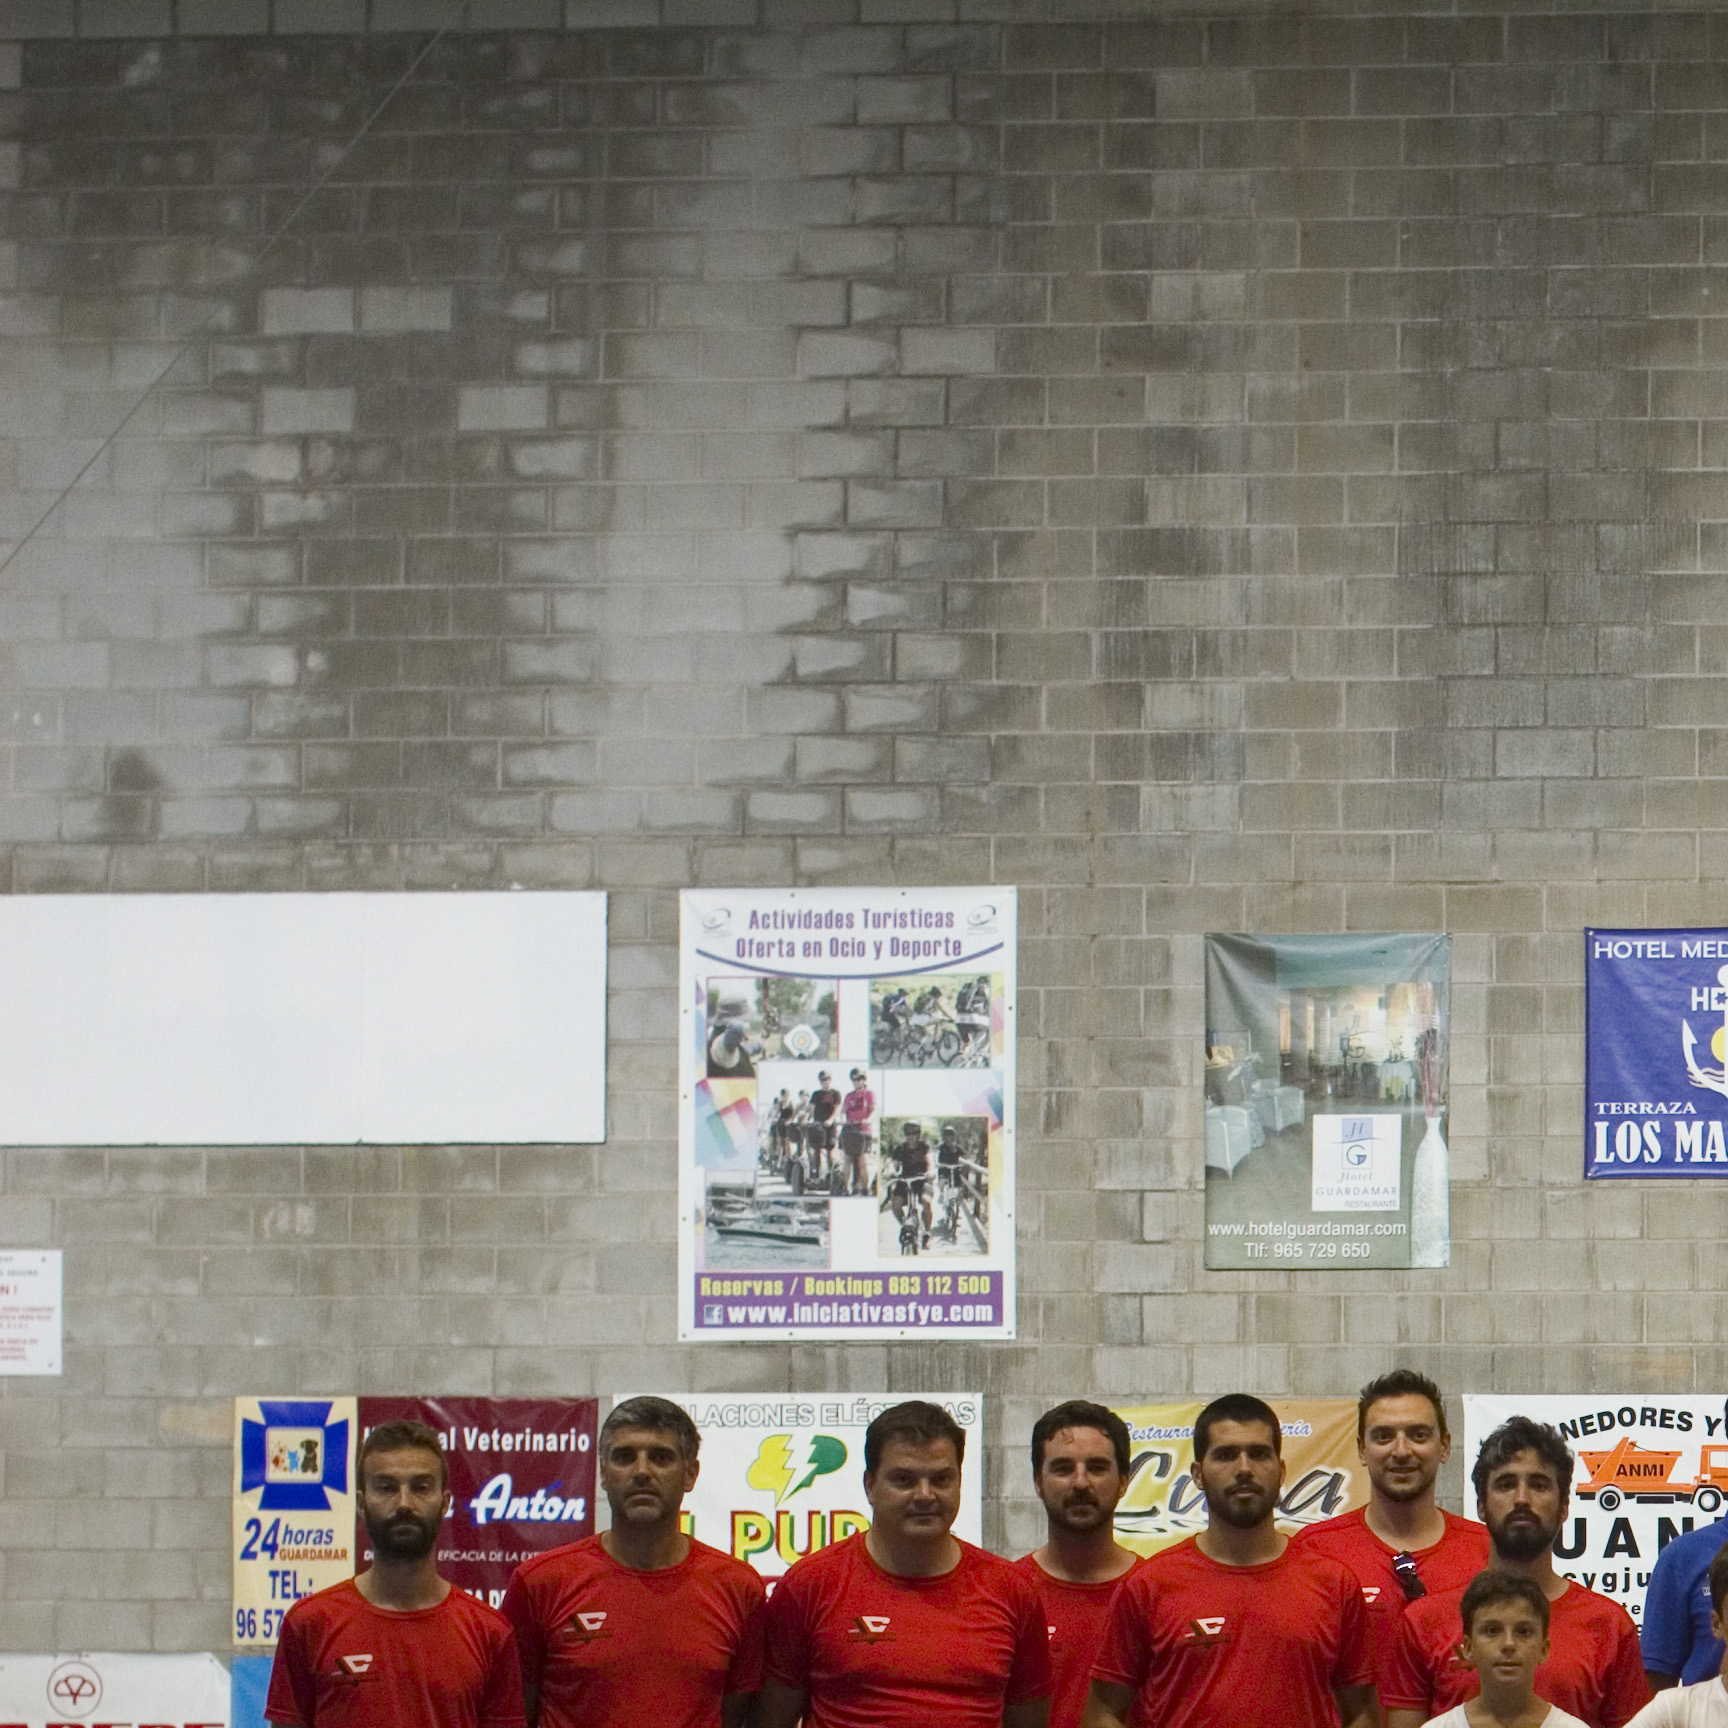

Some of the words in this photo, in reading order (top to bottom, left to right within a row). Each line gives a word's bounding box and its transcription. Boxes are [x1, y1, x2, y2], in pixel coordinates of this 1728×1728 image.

[749, 910, 854, 930] Actividades
[736, 938, 795, 958] Oferta
[802, 941, 822, 957] en
[829, 937, 865, 957] Ocio
[873, 942, 882, 960] y
[890, 938, 961, 959] Deporte
[1594, 941, 1675, 959] HOTEL
[1691, 987, 1709, 1011] H
[1594, 1101, 1697, 1115] TERRAZA
[1594, 1120, 1662, 1163] LOS
[1316, 1186, 1397, 1196] GUARDAMAR
[1208, 1221, 1406, 1239] www.hotelguardamar.com
[1274, 1243, 1303, 1258] 965
[1309, 1243, 1337, 1258] 729
[1342, 1243, 1370, 1258] 650
[701, 1277, 783, 1296] Reservas
[804, 1277, 883, 1298] Bookings
[889, 1277, 920, 1295] 683
[927, 1276, 951, 1294] 112
[957, 1276, 990, 1294] 500
[727, 1302, 993, 1325] www.iniciativasfye.com
[697, 1404, 815, 1427] LACIONES
[1560, 1407, 1693, 1440] NEDORES
[464, 1427, 590, 1452] Veterinario
[241, 1518, 280, 1560] 24
[282, 1523, 333, 1546] horas
[279, 1548, 348, 1562] GUARDAMAR
[438, 1551, 486, 1562] EFICACIA
[489, 1551, 503, 1562] DE
[505, 1552, 518, 1562] LA
[236, 1609, 257, 1639] 96
